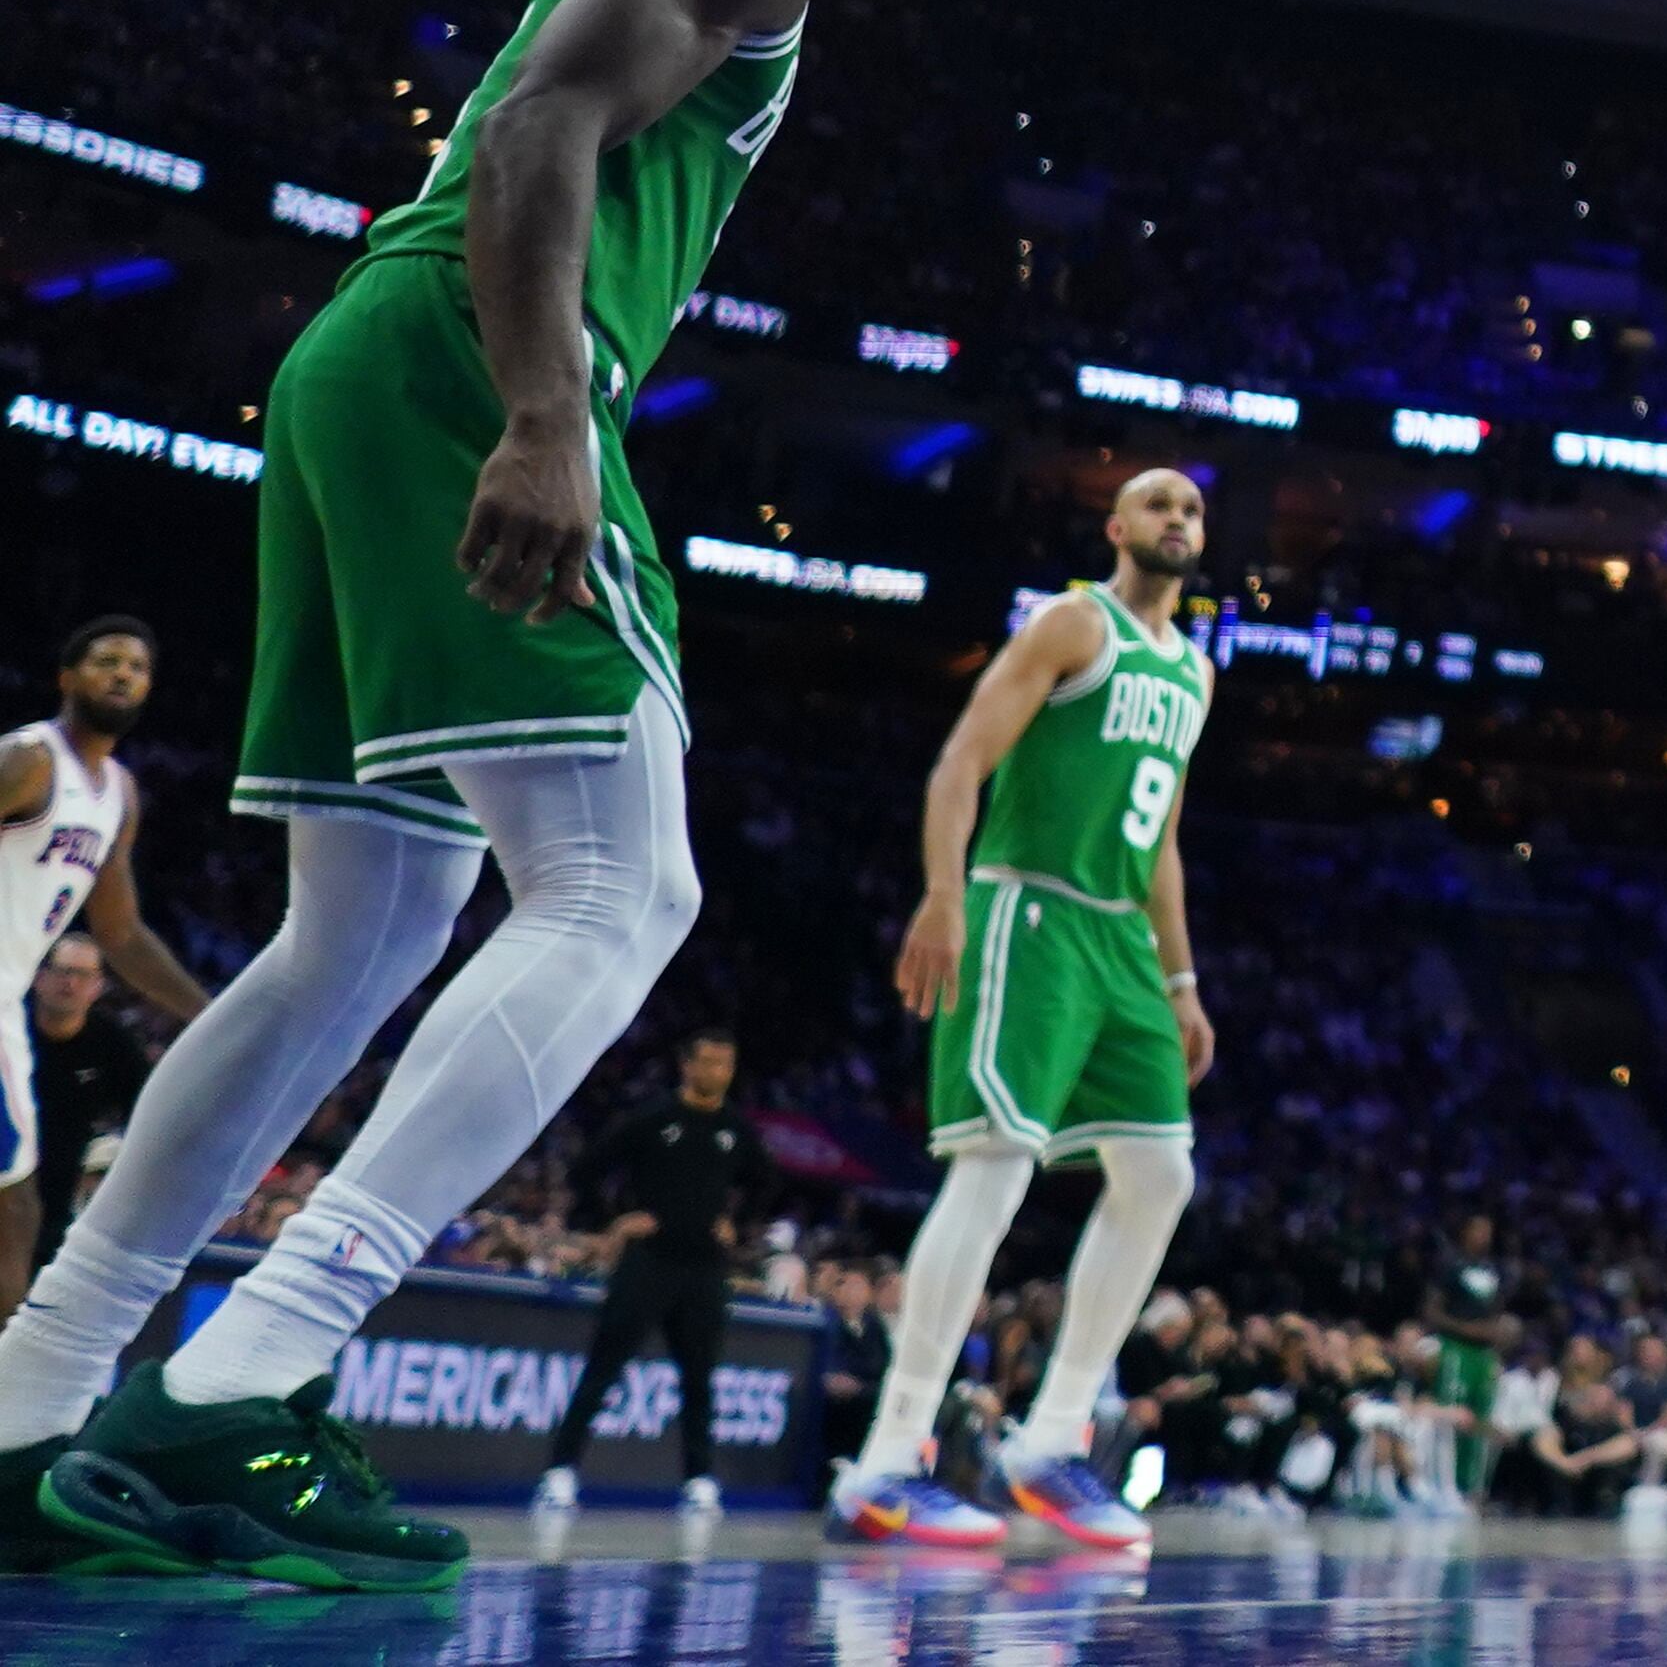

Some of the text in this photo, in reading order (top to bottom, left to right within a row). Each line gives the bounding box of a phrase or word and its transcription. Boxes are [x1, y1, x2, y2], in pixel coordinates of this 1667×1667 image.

[6, 394, 266, 484] ALL DAY! EVER
[1101, 672, 1202, 761] BOSTO
[1121, 756, 1178, 850] 9
[330, 1336, 792, 1447] MERICAN EXPESS
